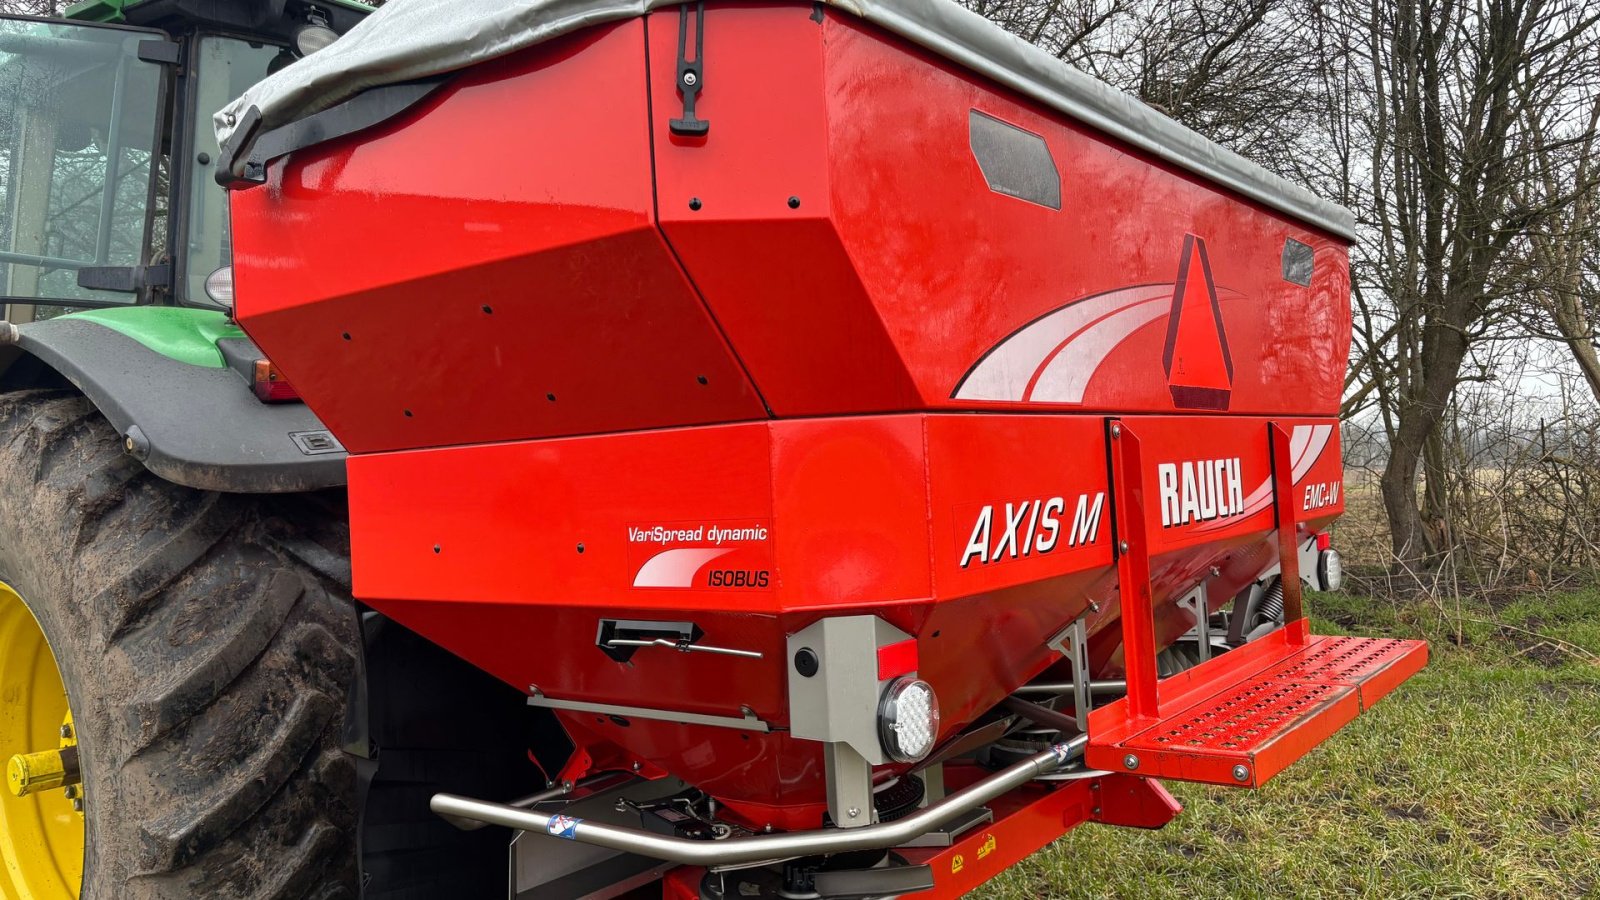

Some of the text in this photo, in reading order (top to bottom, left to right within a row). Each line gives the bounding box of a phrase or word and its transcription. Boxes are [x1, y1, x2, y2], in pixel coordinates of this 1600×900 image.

[1158, 457, 1245, 528] RAUCH
[1303, 481, 1341, 511] EMC+W
[628, 524, 768, 545] VariSpread dynamic
[959, 492, 1105, 568] AXIS M
[708, 570, 769, 588] ISOBUS
